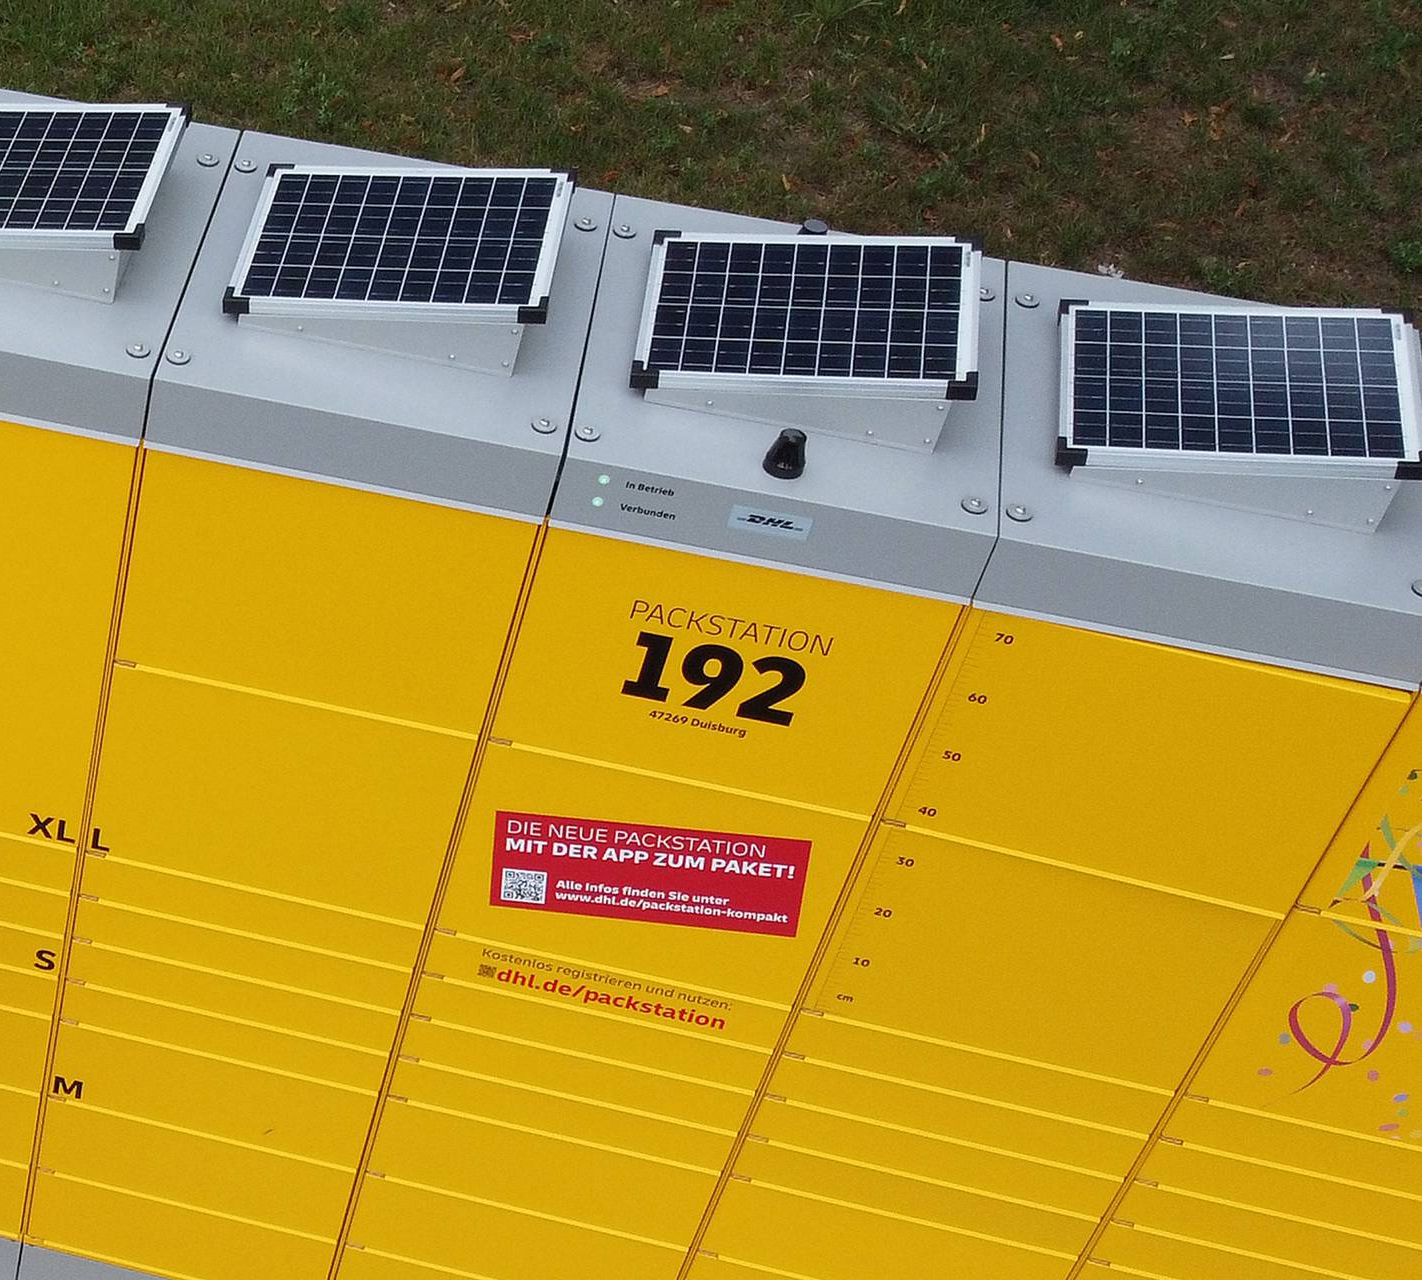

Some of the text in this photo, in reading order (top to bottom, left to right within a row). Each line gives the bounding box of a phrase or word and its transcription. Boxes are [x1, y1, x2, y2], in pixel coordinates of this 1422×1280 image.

[625, 481, 675, 497] In Betrieb
[620, 503, 676, 521] Verbunden
[746, 513, 795, 530] DHL
[629, 600, 834, 657] PACKSTATION
[994, 632, 1014, 645] 70
[620, 631, 807, 727] 192
[968, 693, 988, 704] 60
[649, 710, 747, 738] 47269 Duisburg
[942, 750, 961, 762] 50
[918, 806, 937, 817] 40
[27, 813, 76, 844] XL
[507, 819, 767, 858] DIE NEUE PACKSTATION
[91, 828, 110, 852] L
[505, 837, 796, 880] MIT DER APP ZUM PAKET!
[896, 856, 914, 867] 30
[556, 879, 730, 906] Alle Infos finden Sie unter
[555, 891, 788, 923] www.dhl.de/packstation-kompakt
[874, 907, 892, 918] 20
[34, 950, 56, 970] S
[853, 957, 870, 968] 10
[481, 948, 732, 1011] Kostenlos registrieren und nutzen:
[497, 968, 726, 1030] dhl.de/packstation
[836, 993, 854, 1002] cm
[52, 1076, 84, 1099] M
